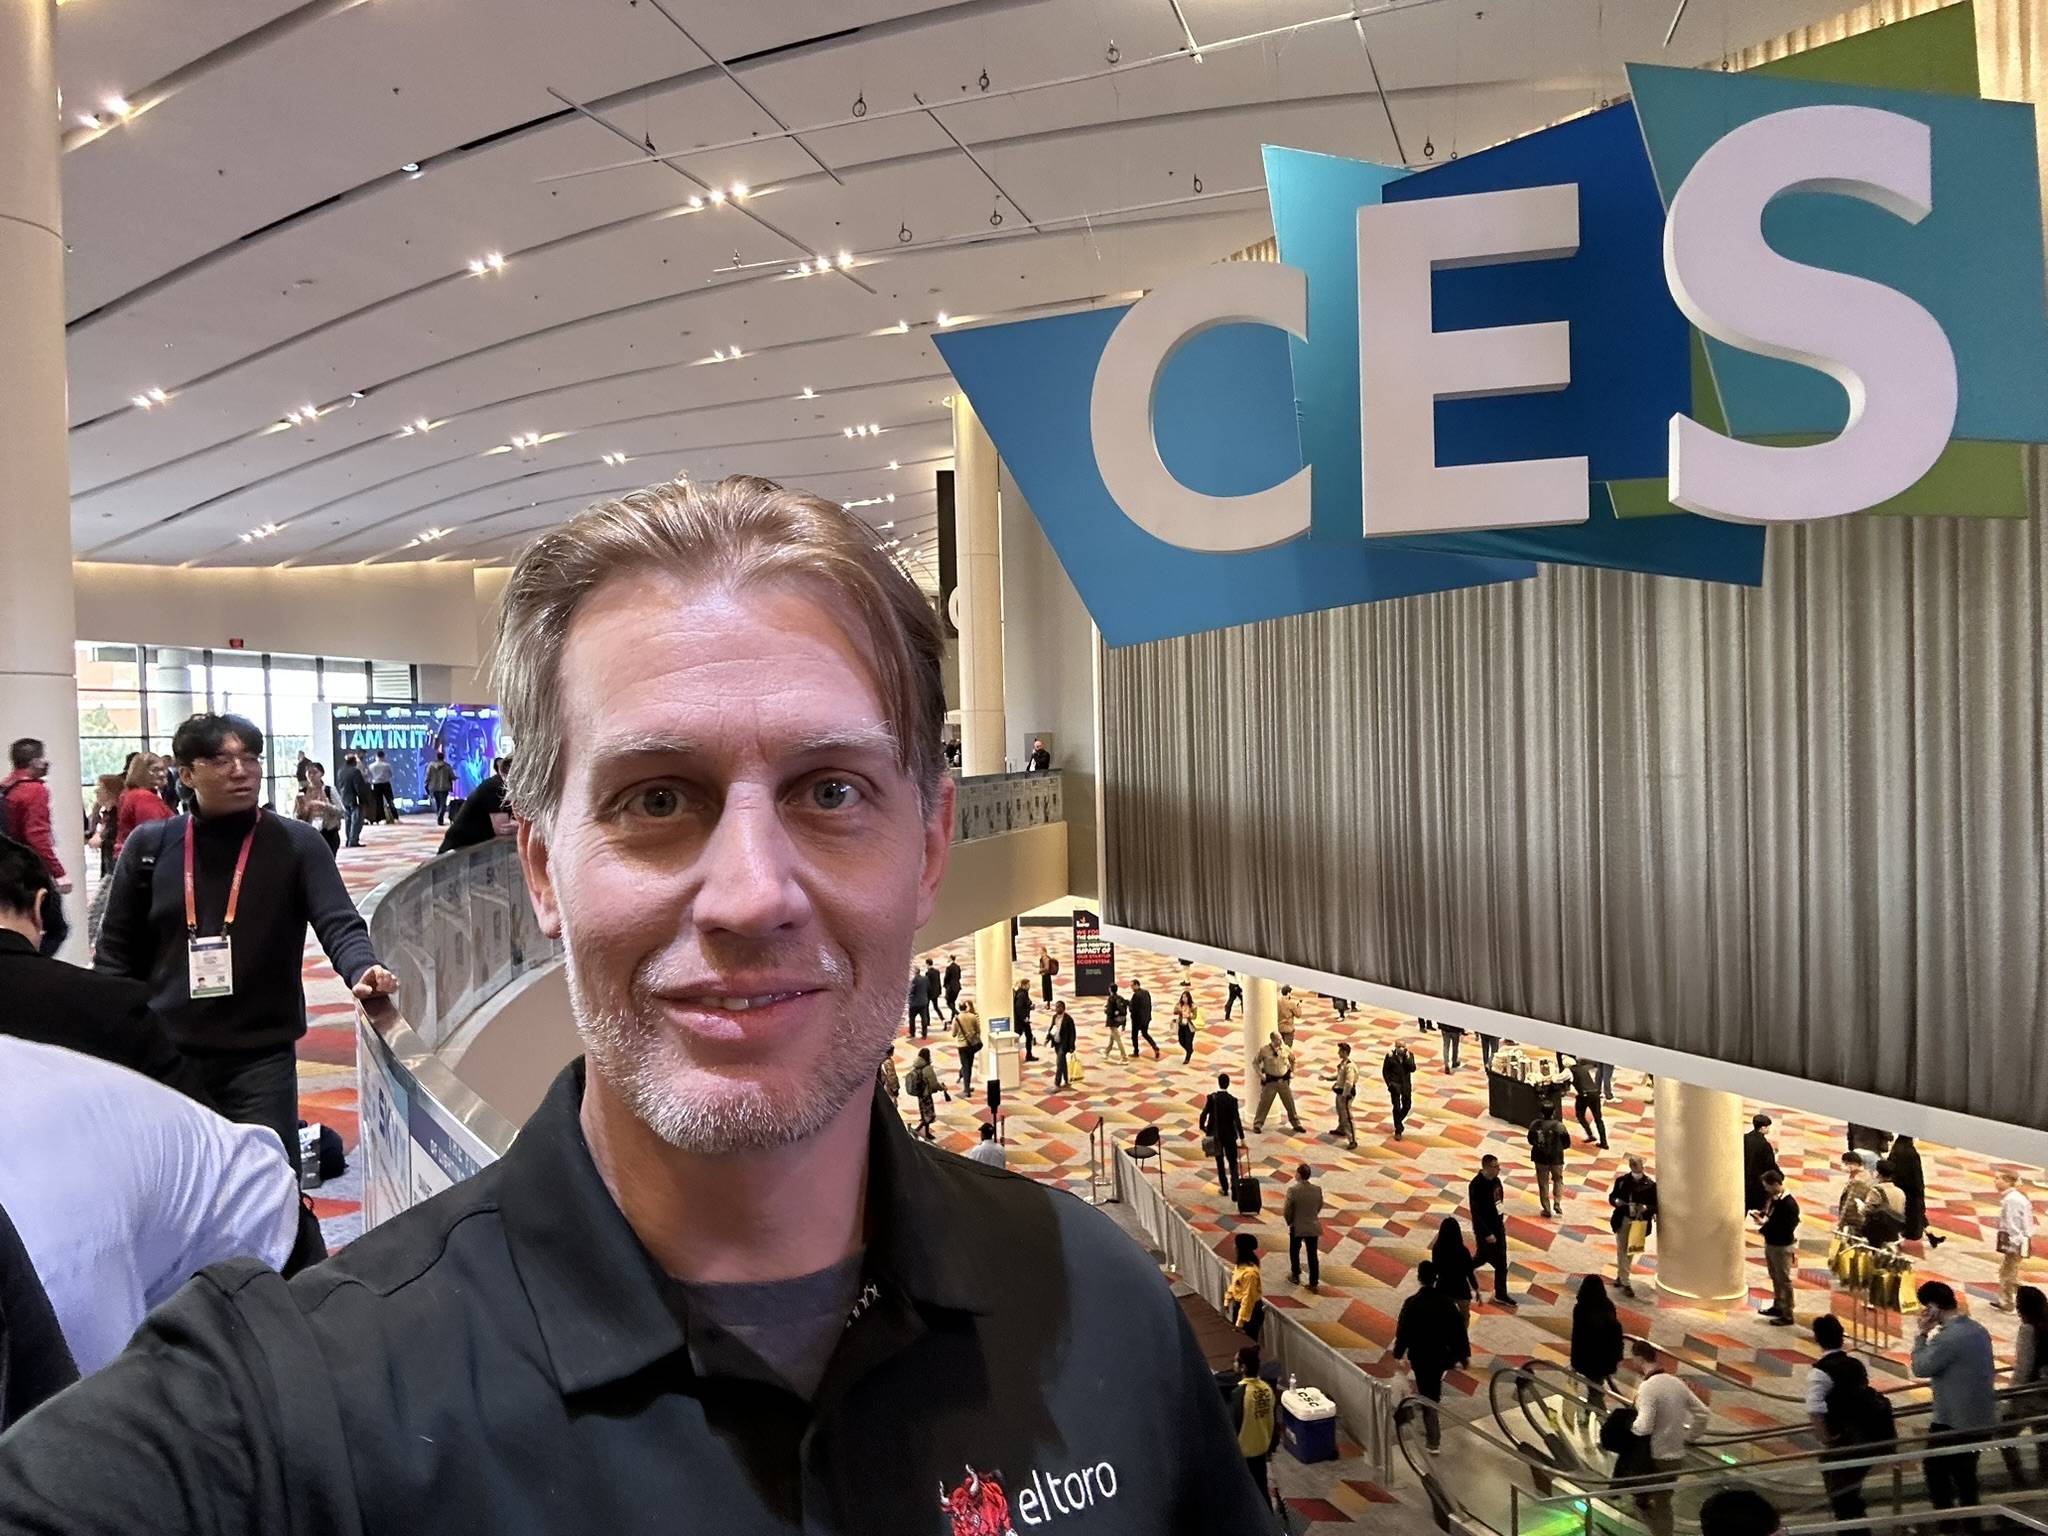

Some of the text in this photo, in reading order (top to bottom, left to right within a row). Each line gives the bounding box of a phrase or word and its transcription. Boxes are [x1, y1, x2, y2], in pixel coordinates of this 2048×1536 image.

[1090, 104, 1958, 553] CES
[340, 729, 426, 749] I AM IN IT
